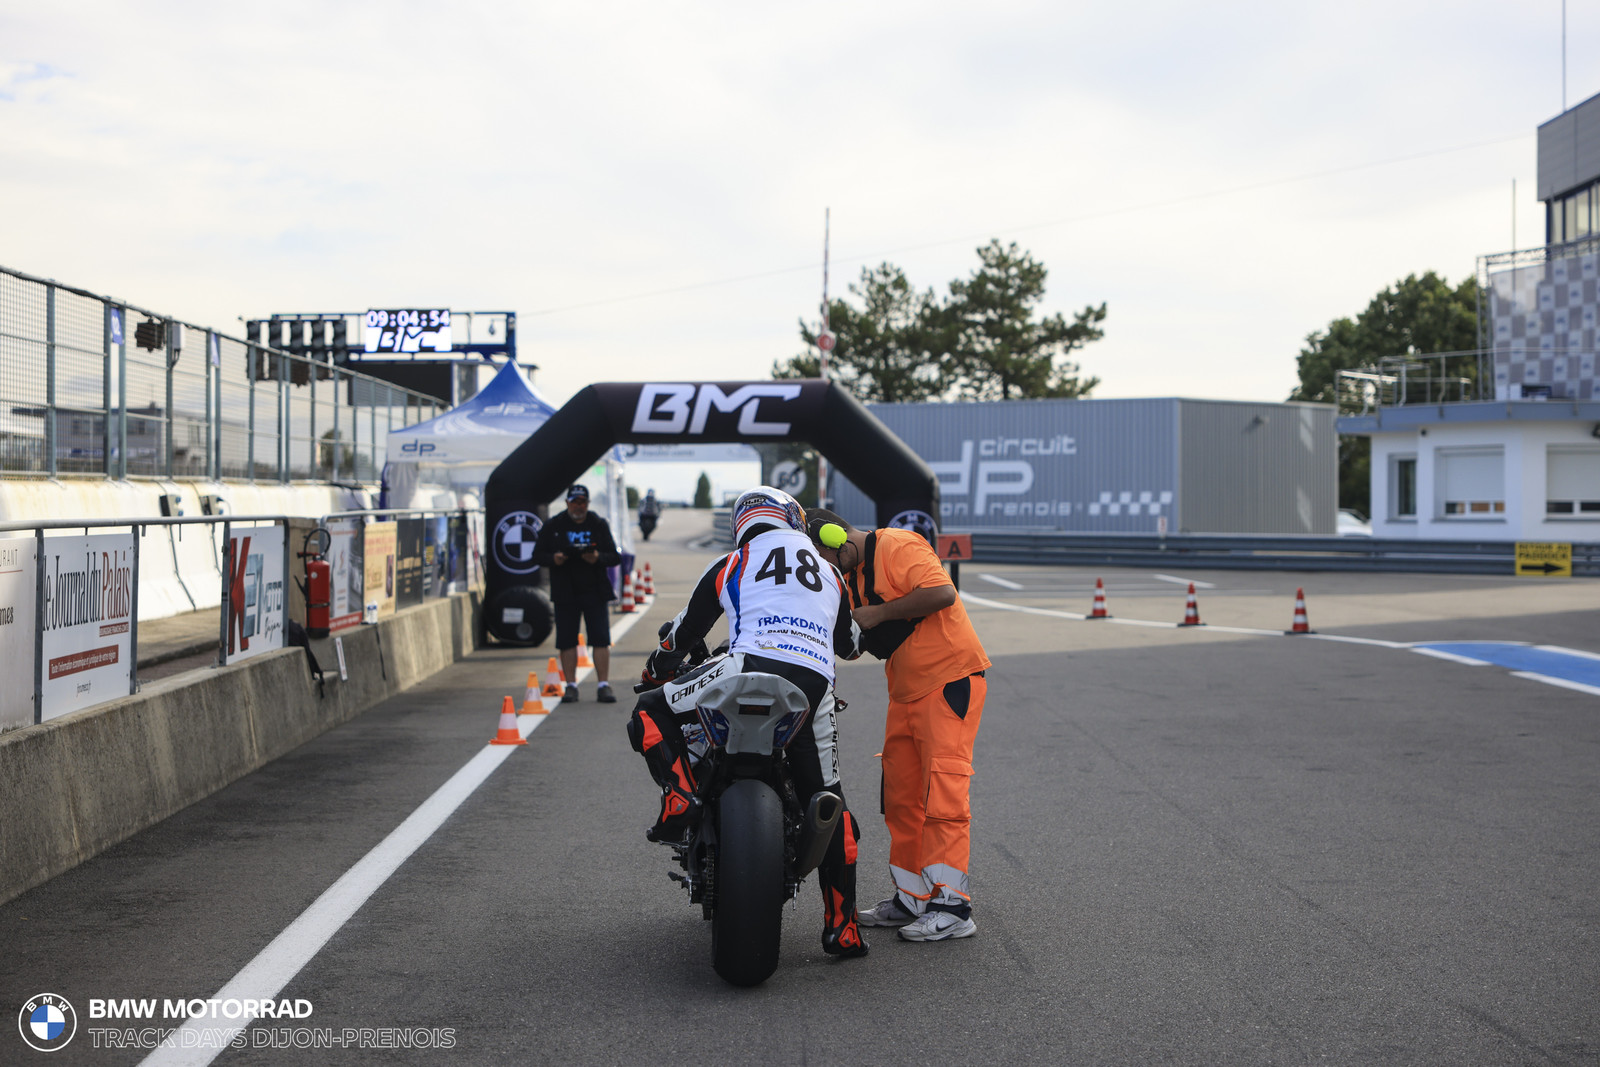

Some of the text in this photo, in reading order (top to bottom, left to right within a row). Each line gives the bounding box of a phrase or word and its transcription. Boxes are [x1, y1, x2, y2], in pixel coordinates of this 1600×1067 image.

[366, 310, 450, 327] 09:04:54
[631, 383, 802, 435] BMC
[401, 438, 436, 457] dp
[979, 435, 1077, 456] circuit
[948, 541, 962, 557] A
[755, 546, 823, 593] 48
[52, 552, 90, 630] Journal
[90, 552, 101, 623] du
[101, 550, 130, 620] Palais
[758, 615, 828, 638] TRACKDAYS
[777, 643, 829, 665] MICHELIN
[671, 664, 725, 704] DAINESE
